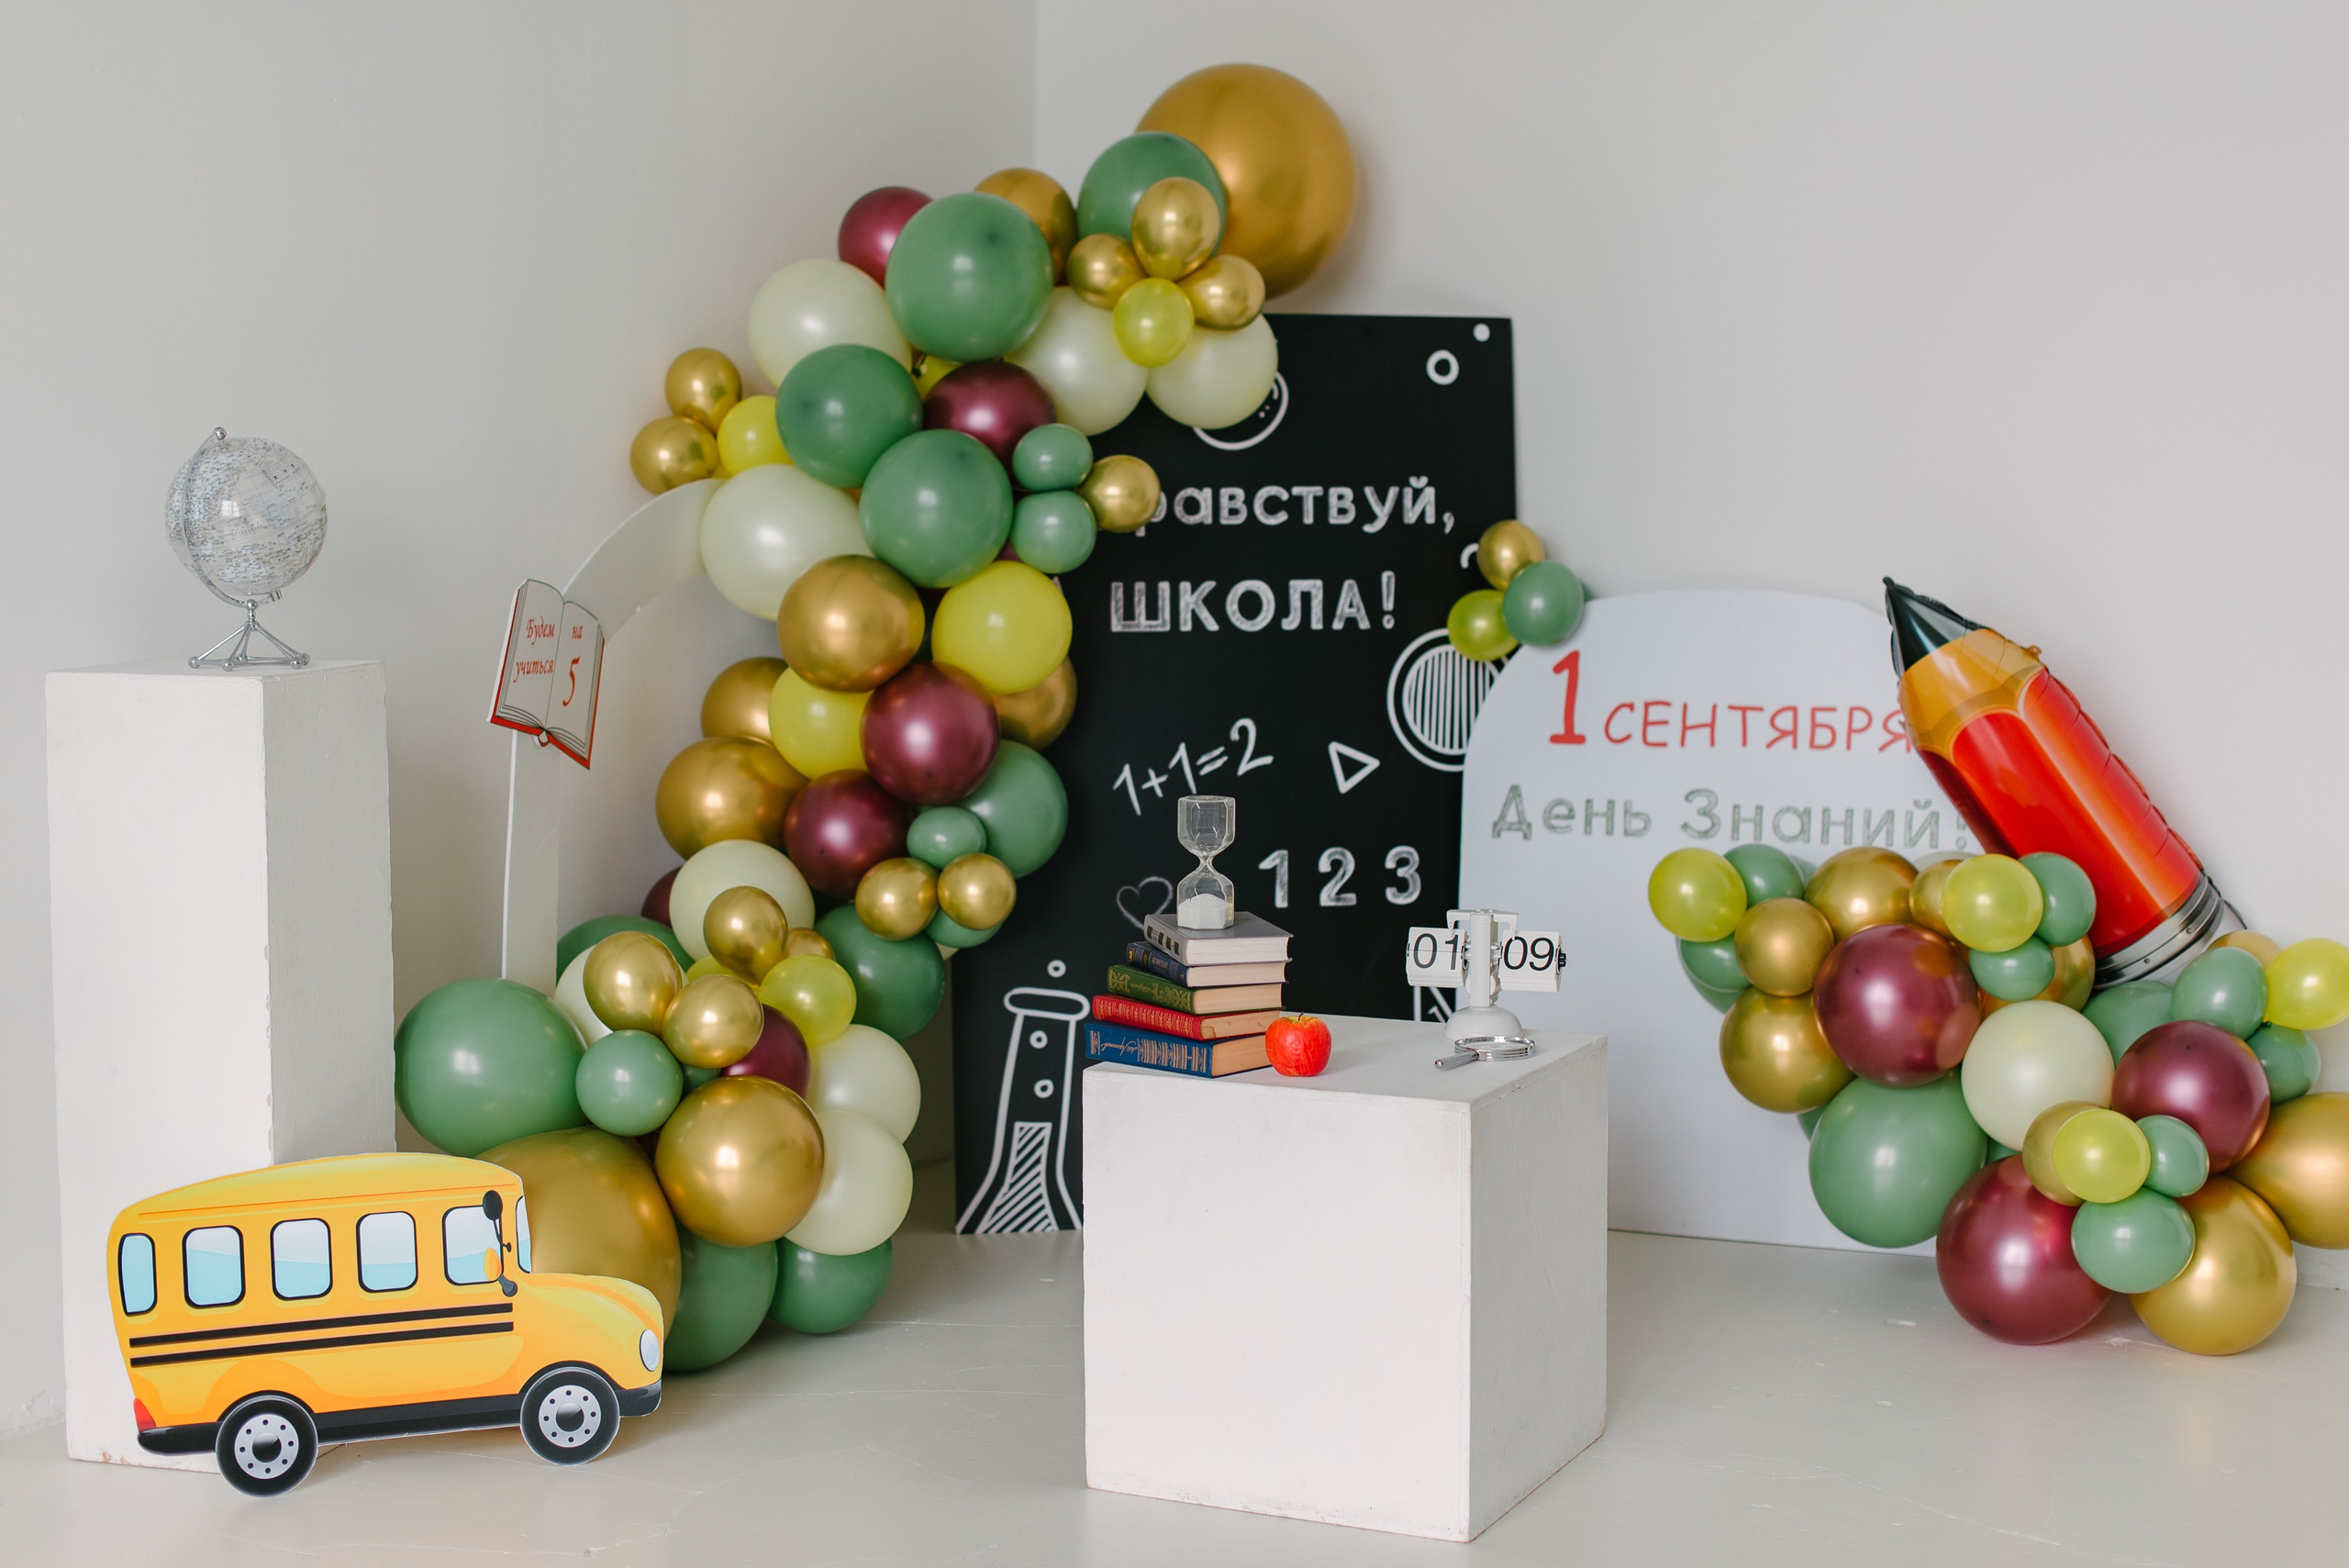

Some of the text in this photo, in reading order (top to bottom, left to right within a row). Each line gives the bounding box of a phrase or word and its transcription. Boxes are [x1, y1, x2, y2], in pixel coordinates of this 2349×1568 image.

[1109, 570, 1396, 632] ШКОЛА!
[526, 615, 555, 646] Будем
[572, 624, 584, 639] на
[513, 659, 555, 684] учиться
[562, 656, 581, 706] 5
[1549, 649, 1911, 753] 1 СЕНТЯБРЯ
[1492, 784, 1652, 841] День
[1258, 845, 1422, 908] 1 2 3
[1413, 932, 1555, 972] 01 09
